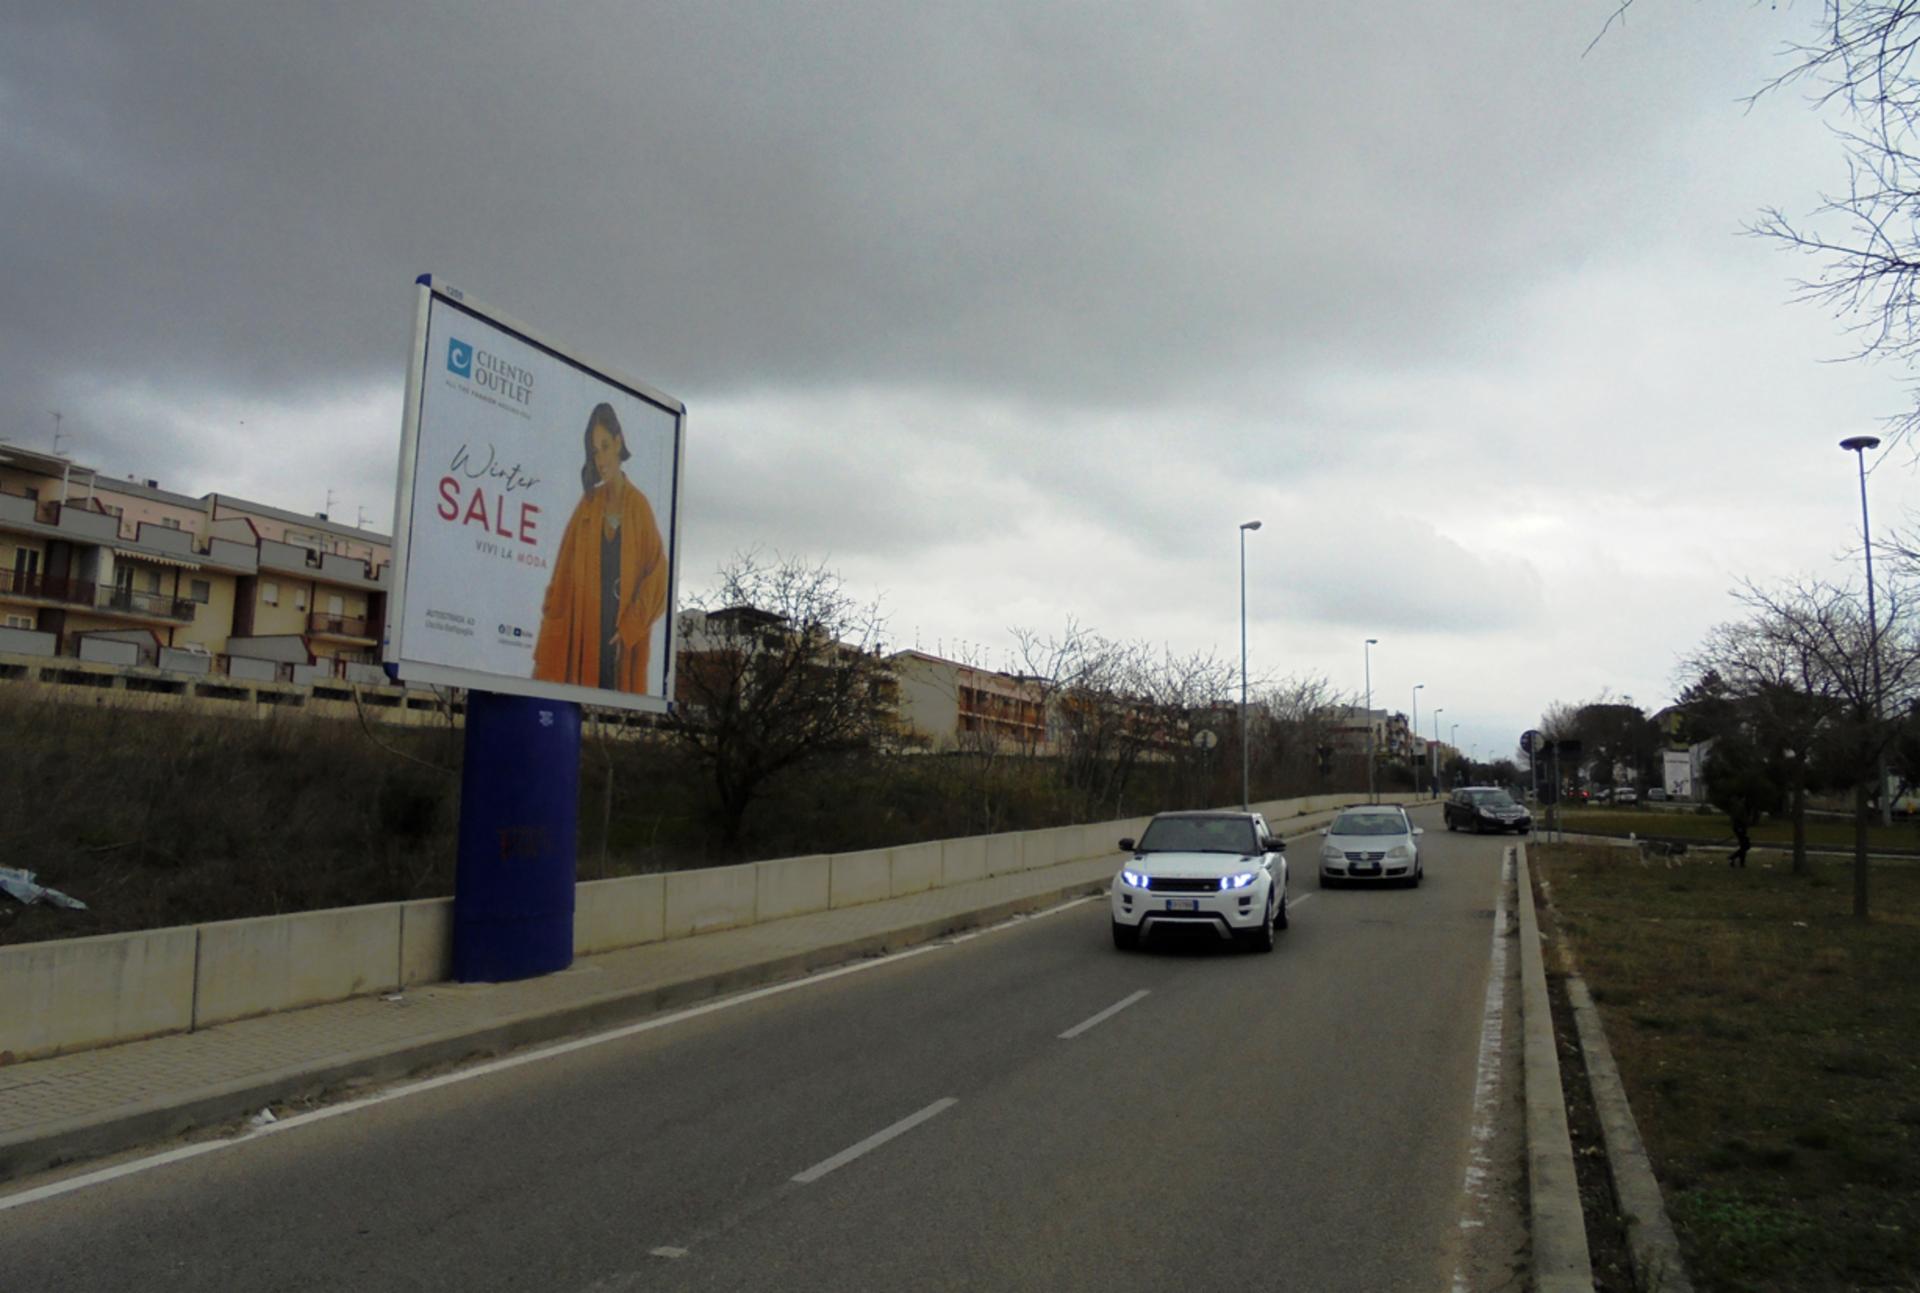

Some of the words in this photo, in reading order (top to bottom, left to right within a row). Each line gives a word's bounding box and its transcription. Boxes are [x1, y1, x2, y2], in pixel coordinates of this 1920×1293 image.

[475, 367, 531, 406] OUTLET
[477, 350, 534, 388] CILENTO
[451, 443, 541, 492] Winter
[438, 476, 541, 546] SALE
[475, 540, 498, 556] VIVI
[501, 548, 513, 559] LA
[517, 552, 547, 569] MODA
